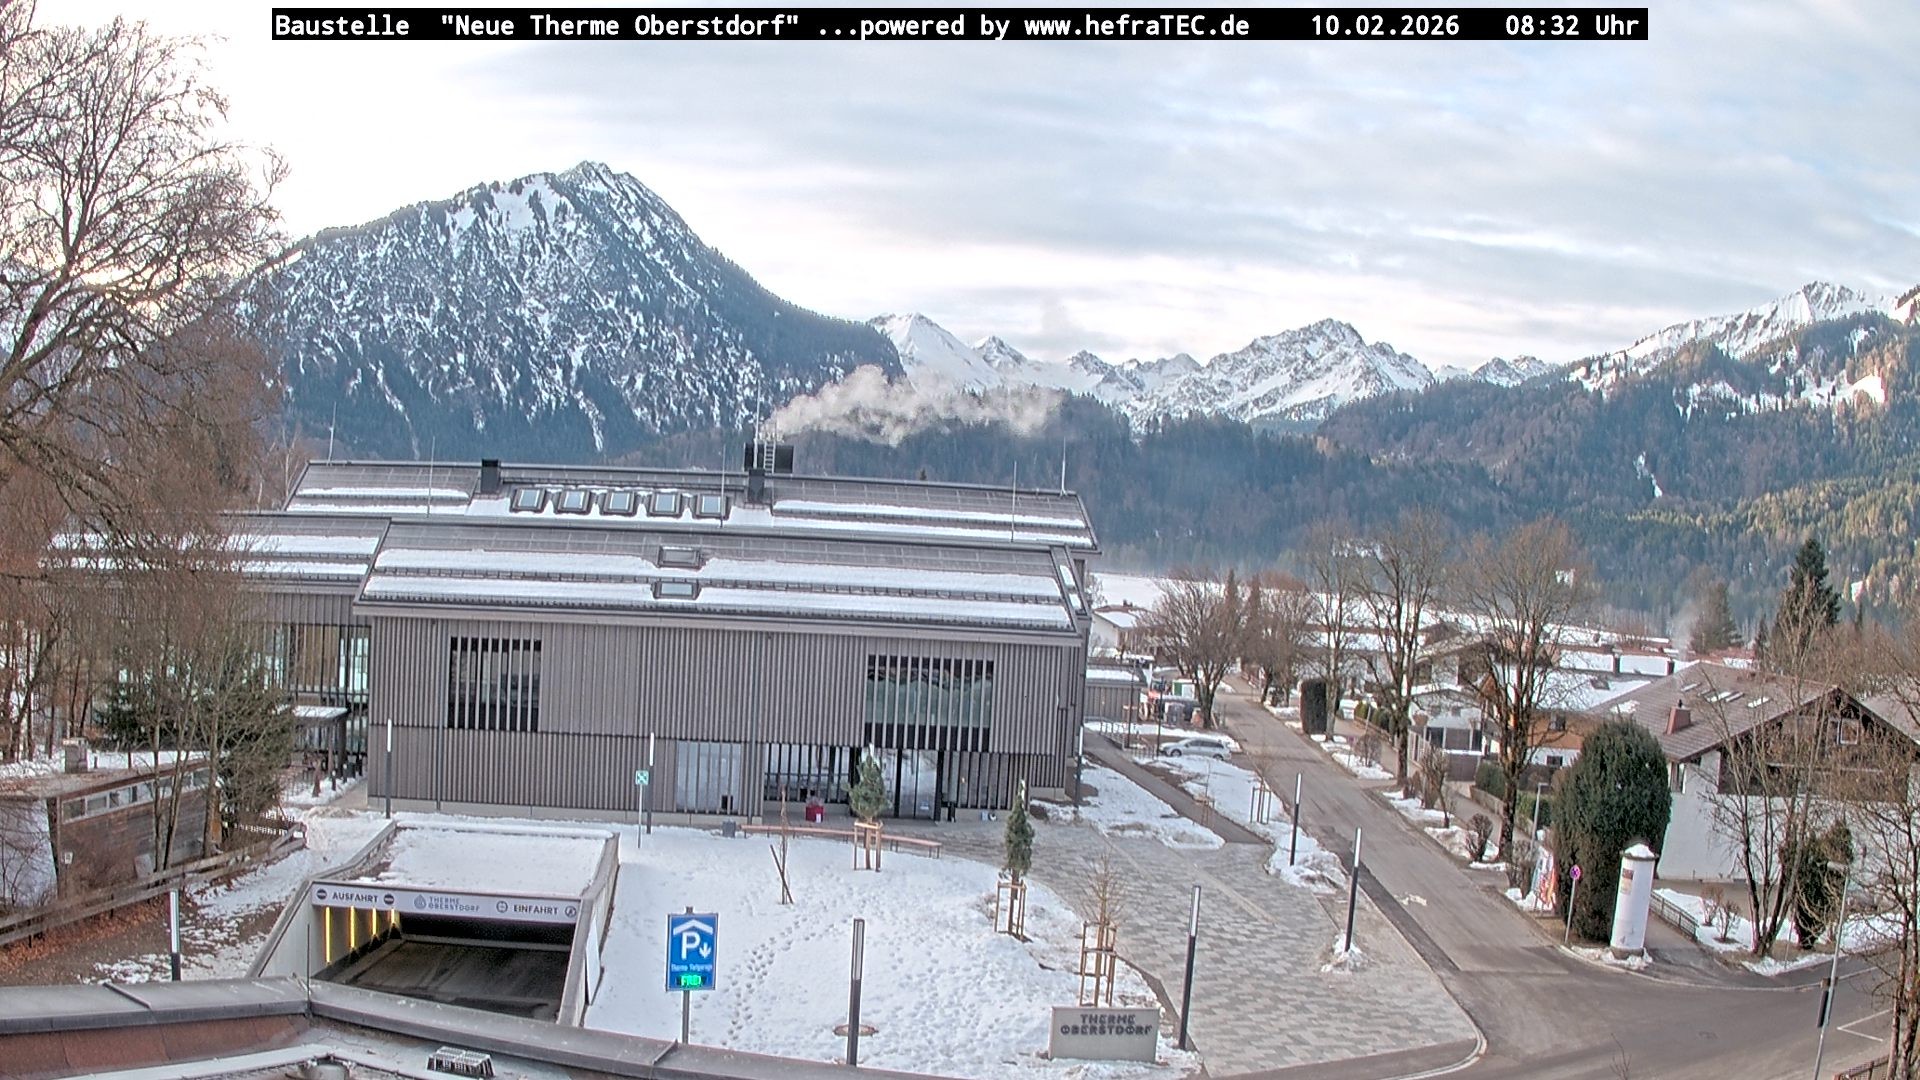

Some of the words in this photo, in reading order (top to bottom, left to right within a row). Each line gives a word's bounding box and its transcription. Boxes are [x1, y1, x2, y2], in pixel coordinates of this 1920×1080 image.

[332, 891, 378, 903] AUSFAHRT
[513, 904, 558, 915] EINFAHRT
[681, 931, 701, 960] P
[1080, 1013, 1136, 1025] THERME
[1060, 1024, 1153, 1036] OBERSTDORF
